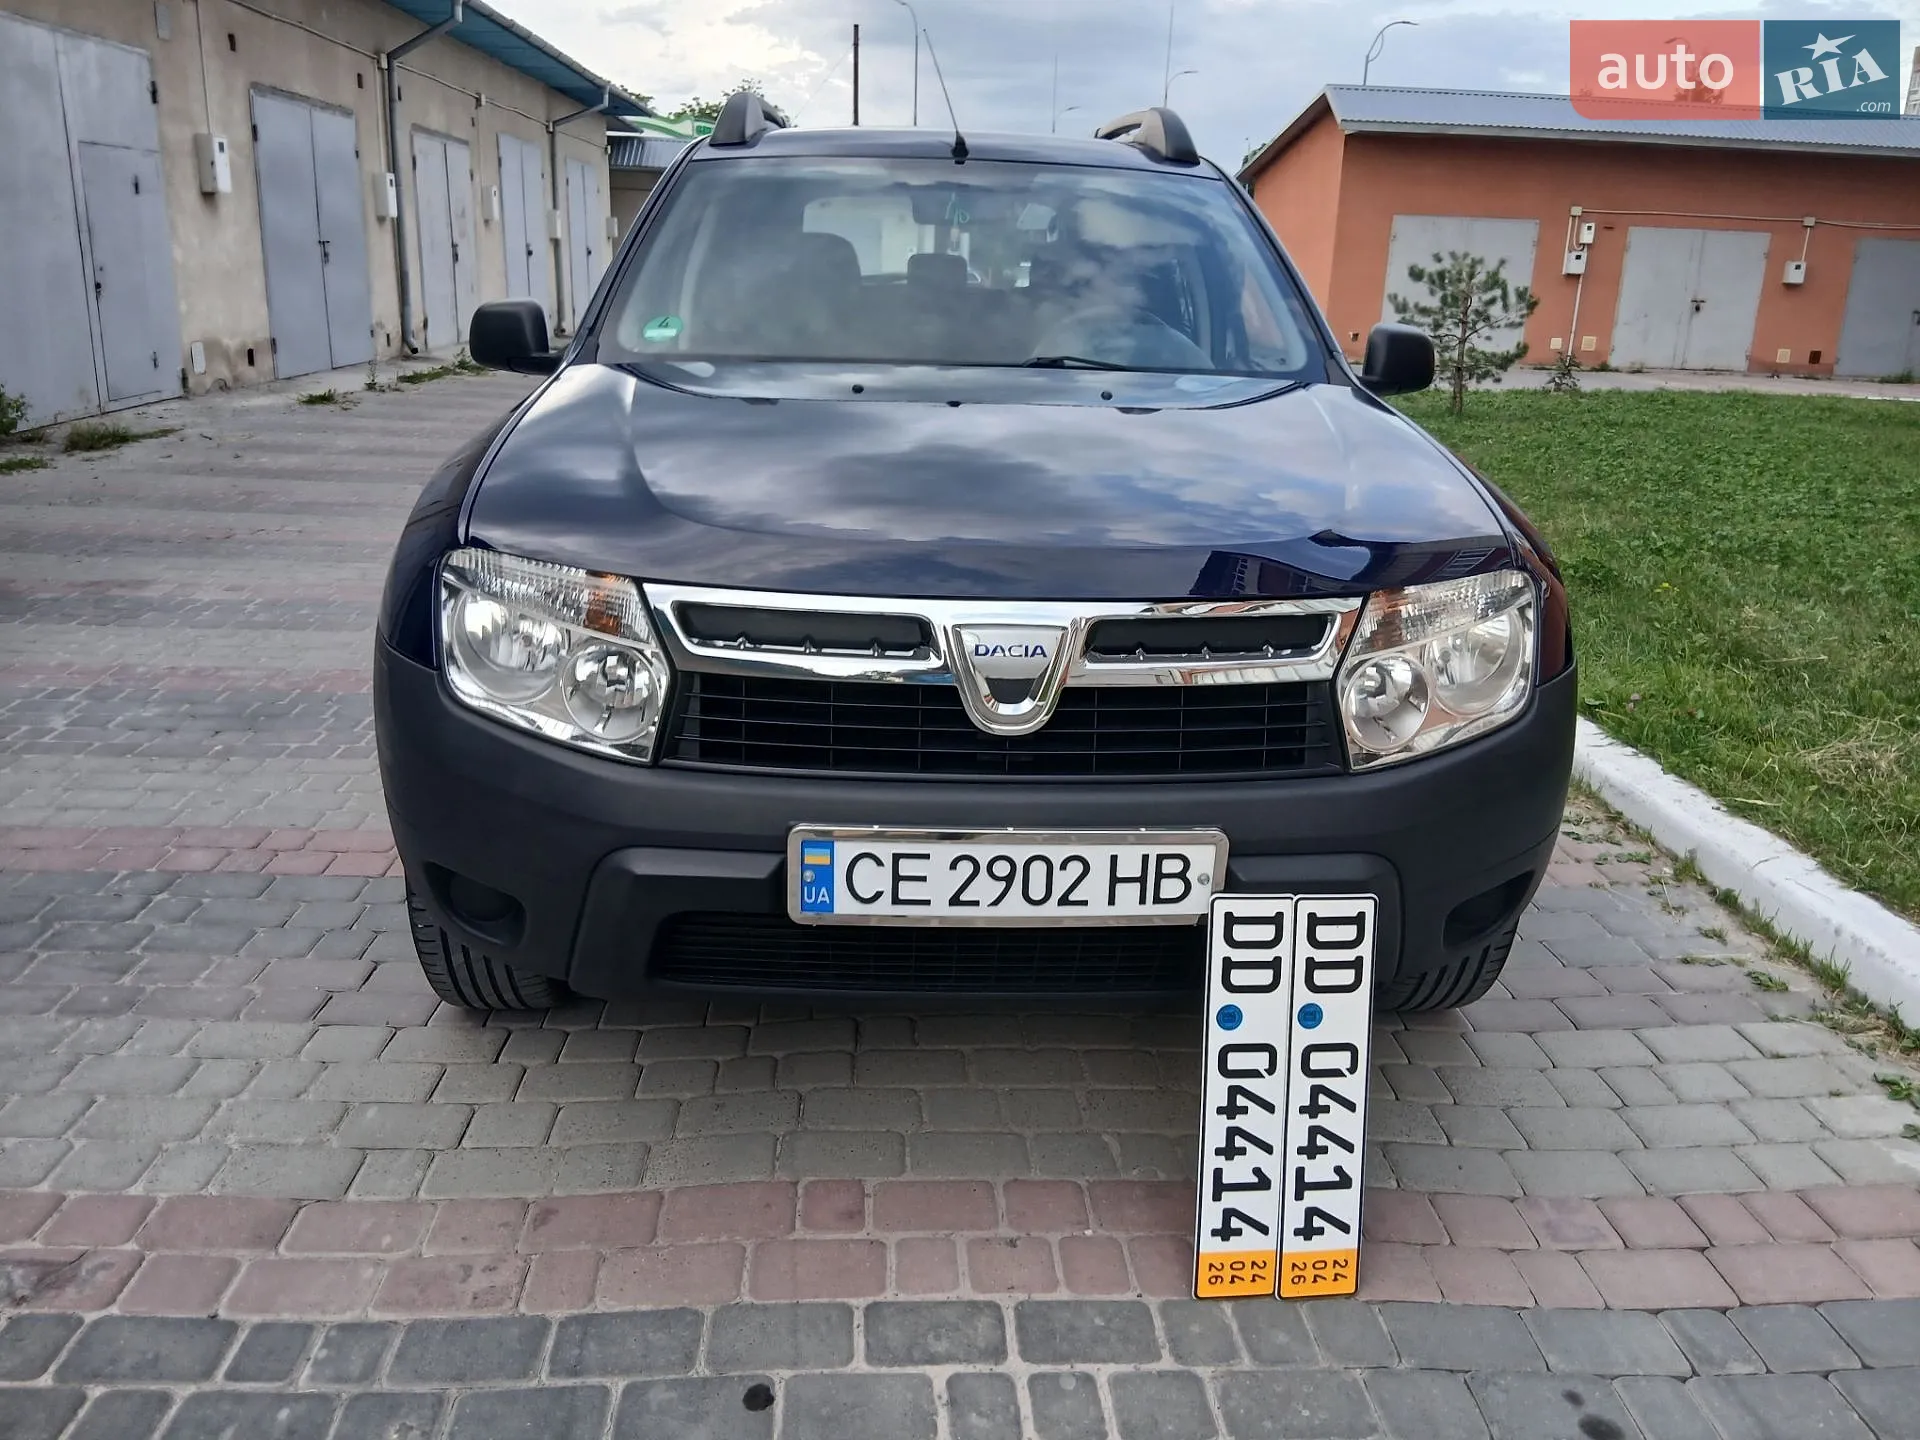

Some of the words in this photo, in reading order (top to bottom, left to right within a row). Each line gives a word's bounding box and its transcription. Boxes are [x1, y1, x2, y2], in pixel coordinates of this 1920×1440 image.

[974, 643, 1047, 658] DACIA
[845, 852, 931, 906] CE
[948, 854, 1091, 907] 2902
[1107, 853, 1192, 906] HB
[803, 886, 830, 904] UA
[1221, 911, 1284, 994] DD
[1304, 911, 1366, 994] DD
[1210, 1043, 1278, 1242] 04414
[1293, 1042, 1359, 1241] 04414
[1208, 1262, 1224, 1285] 26
[1229, 1260, 1246, 1285] 04
[1250, 1260, 1267, 1283] 24
[1291, 1262, 1307, 1285] 26
[1311, 1260, 1328, 1284] 04
[1332, 1259, 1349, 1282] 24
